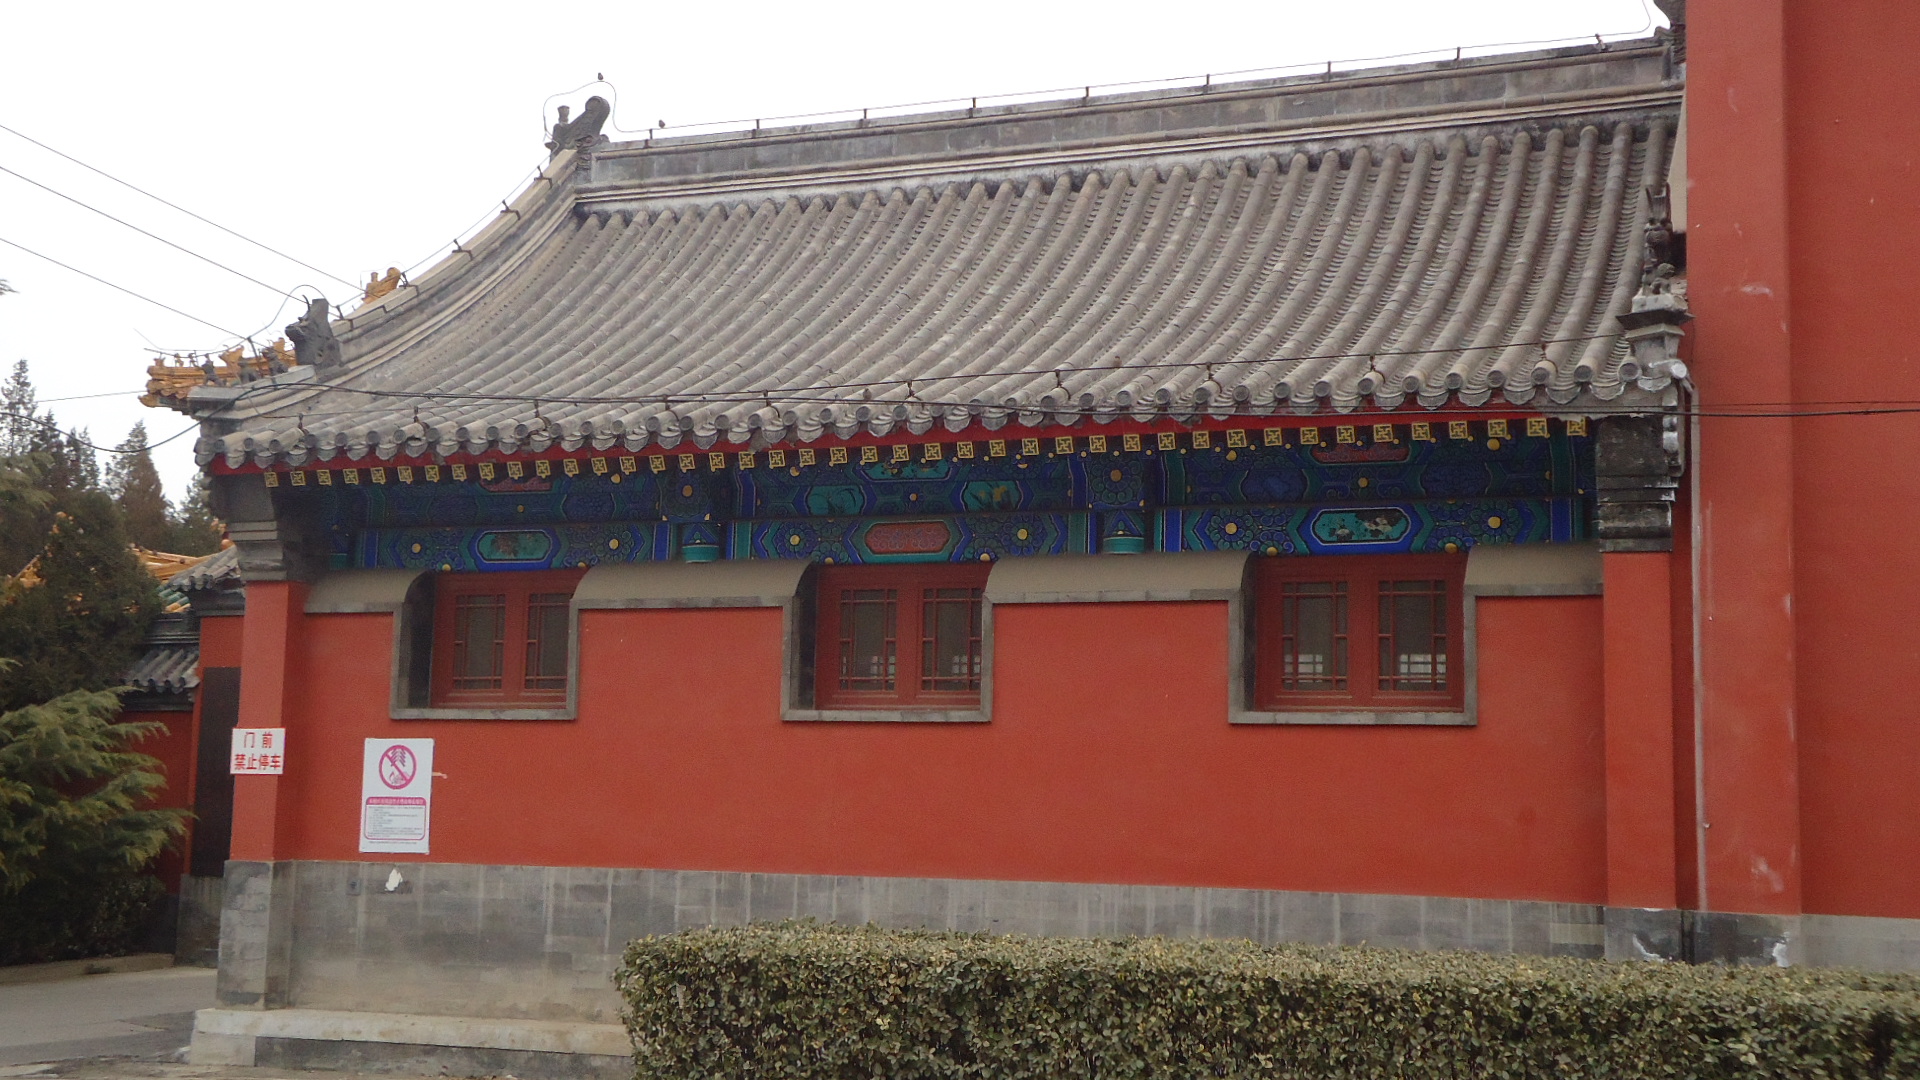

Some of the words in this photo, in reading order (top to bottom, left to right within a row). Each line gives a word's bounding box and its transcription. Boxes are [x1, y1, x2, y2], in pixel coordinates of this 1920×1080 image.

[244, 732, 273, 748] 门前
[235, 754, 281, 770] 禁止停车
